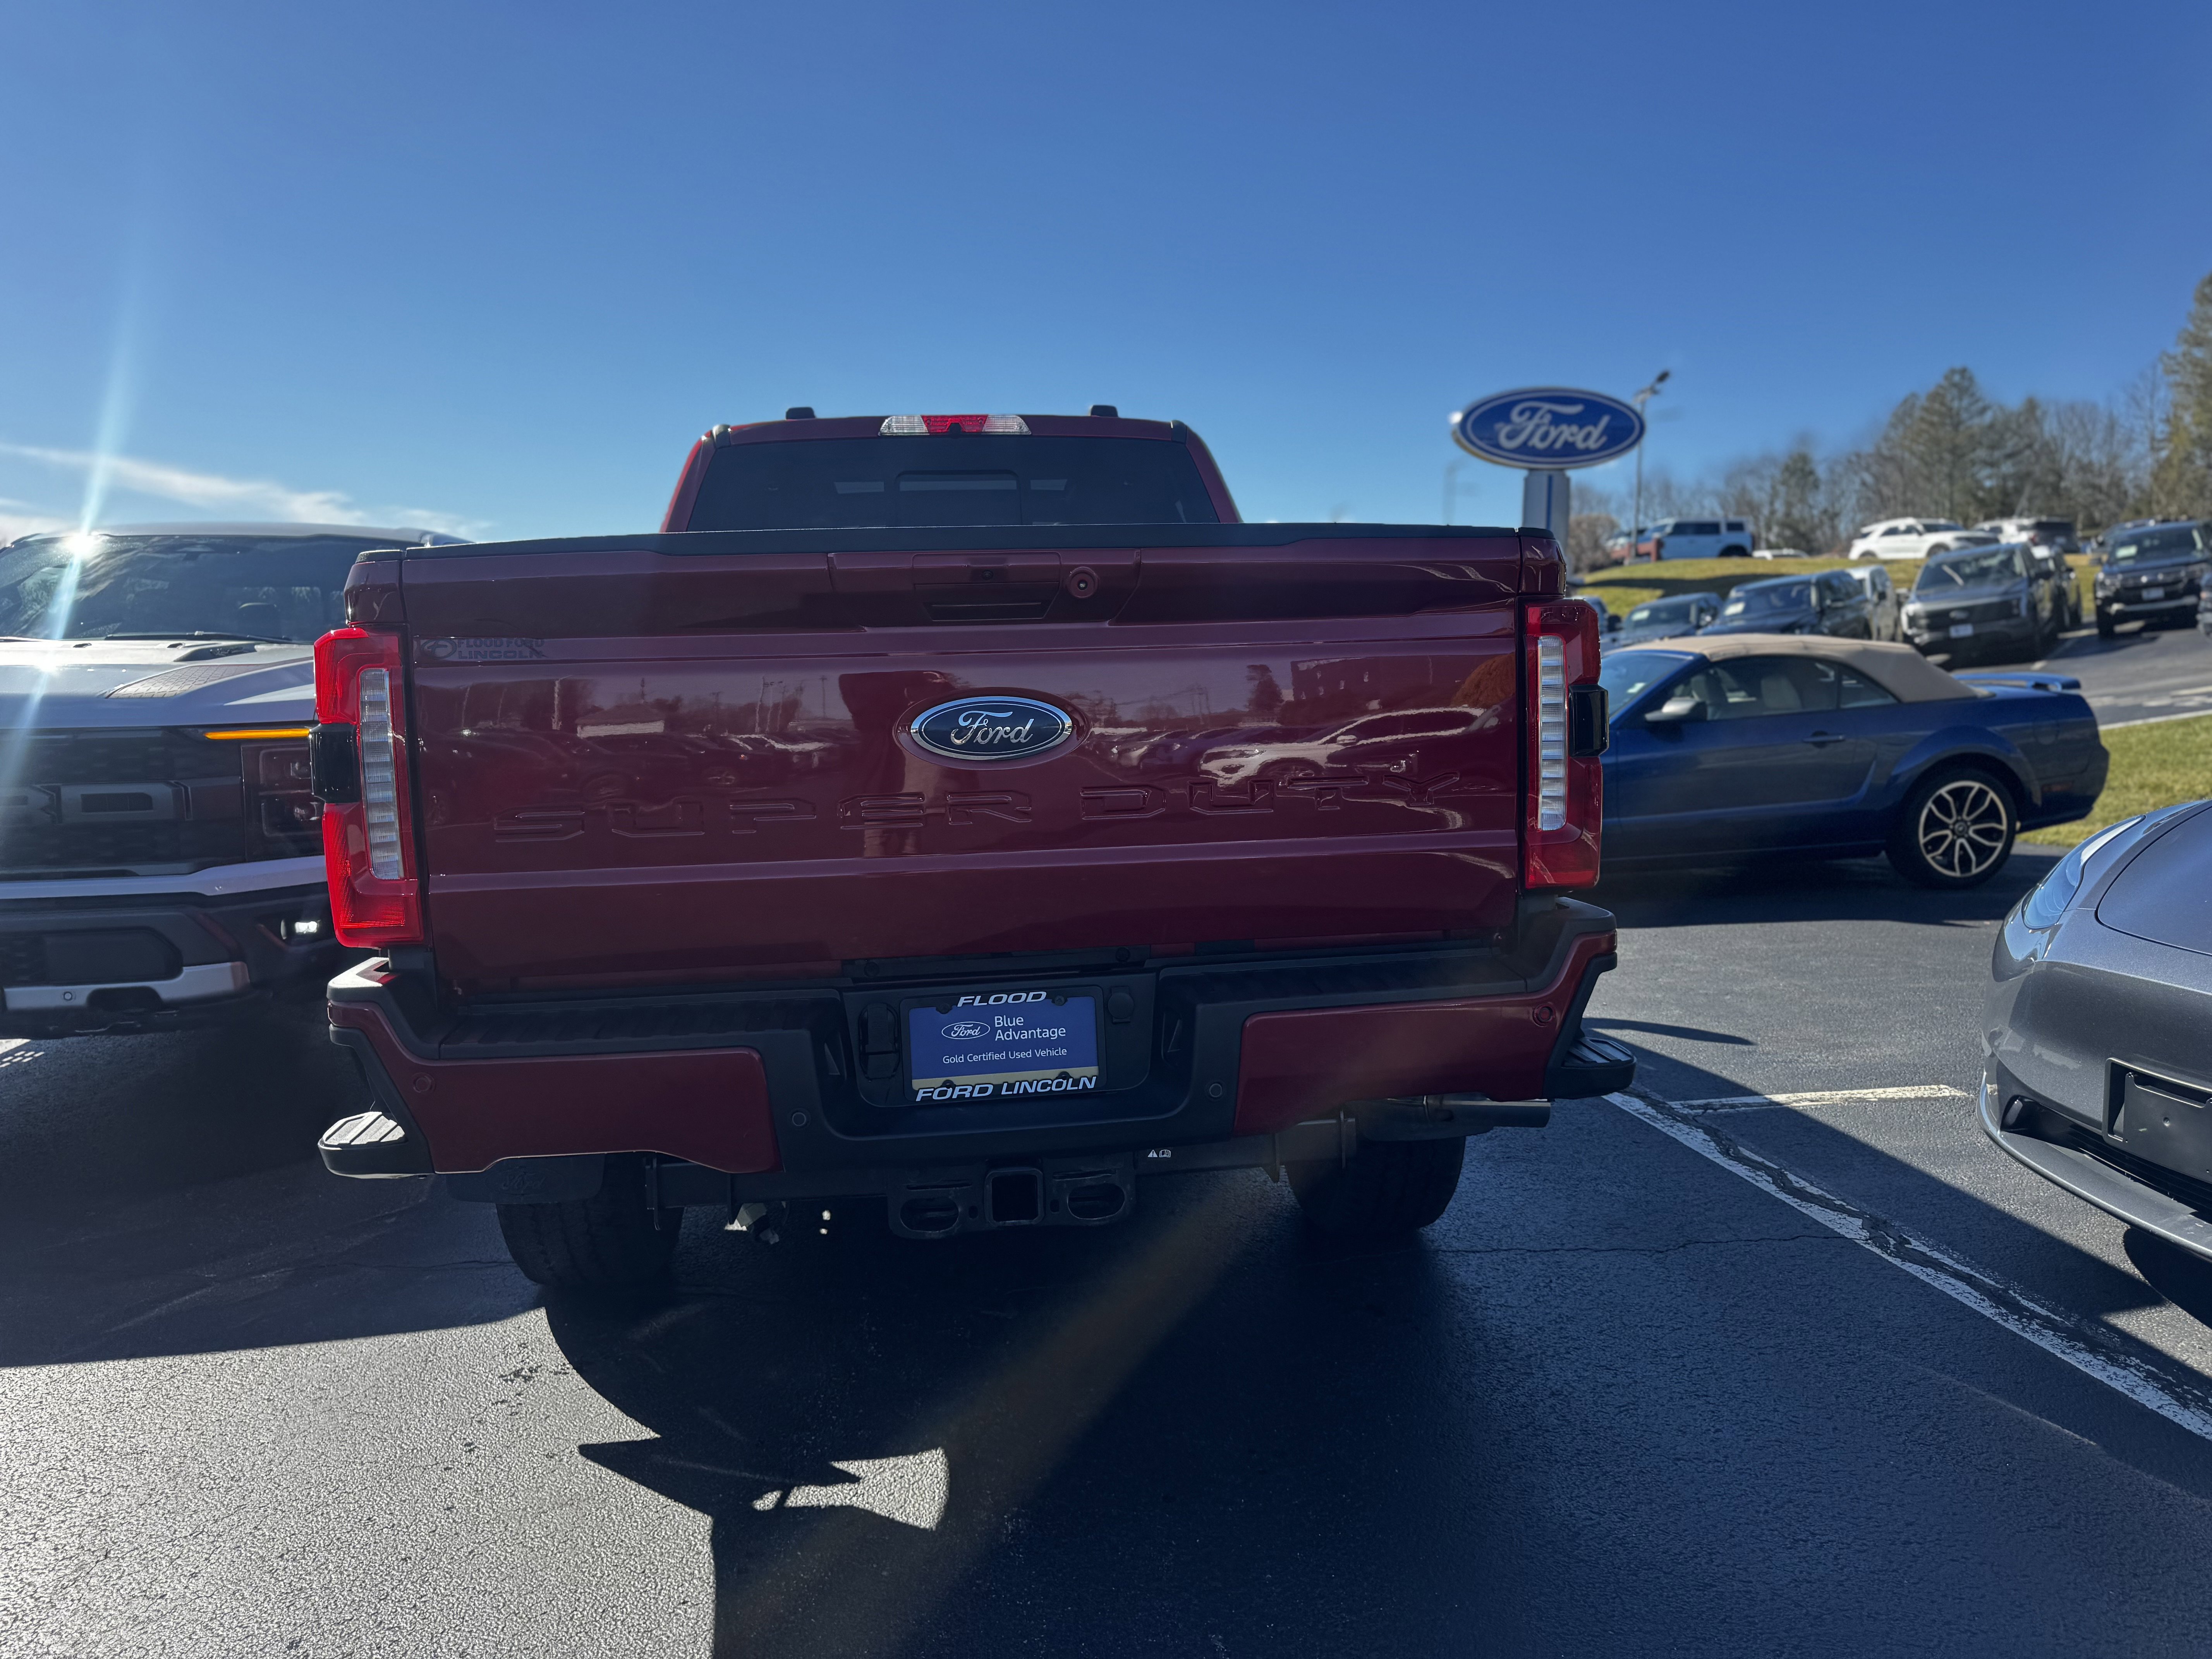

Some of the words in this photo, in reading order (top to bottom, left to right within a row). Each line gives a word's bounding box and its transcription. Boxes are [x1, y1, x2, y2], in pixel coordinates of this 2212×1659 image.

[1494, 400, 1611, 450] Ford
[458, 638, 503, 647] FLOOD
[458, 651, 543, 659] LINCOLN
[950, 711, 1035, 745] Ford
[493, 788, 1032, 843] SUPER
[1080, 771, 1461, 820] DUTY
[957, 991, 1047, 1007] FLOOD
[994, 1015, 1024, 1027] Blue
[951, 1024, 981, 1036] Ford
[995, 1027, 1066, 1041] Advantage
[943, 1055, 964, 1064] Gold
[967, 1051, 1006, 1062] Certified
[1009, 1049, 1032, 1059] Used
[1035, 1047, 1067, 1057] Vehicle
[915, 1084, 993, 1101] FORD
[1001, 1076, 1096, 1095] LINCOLN
